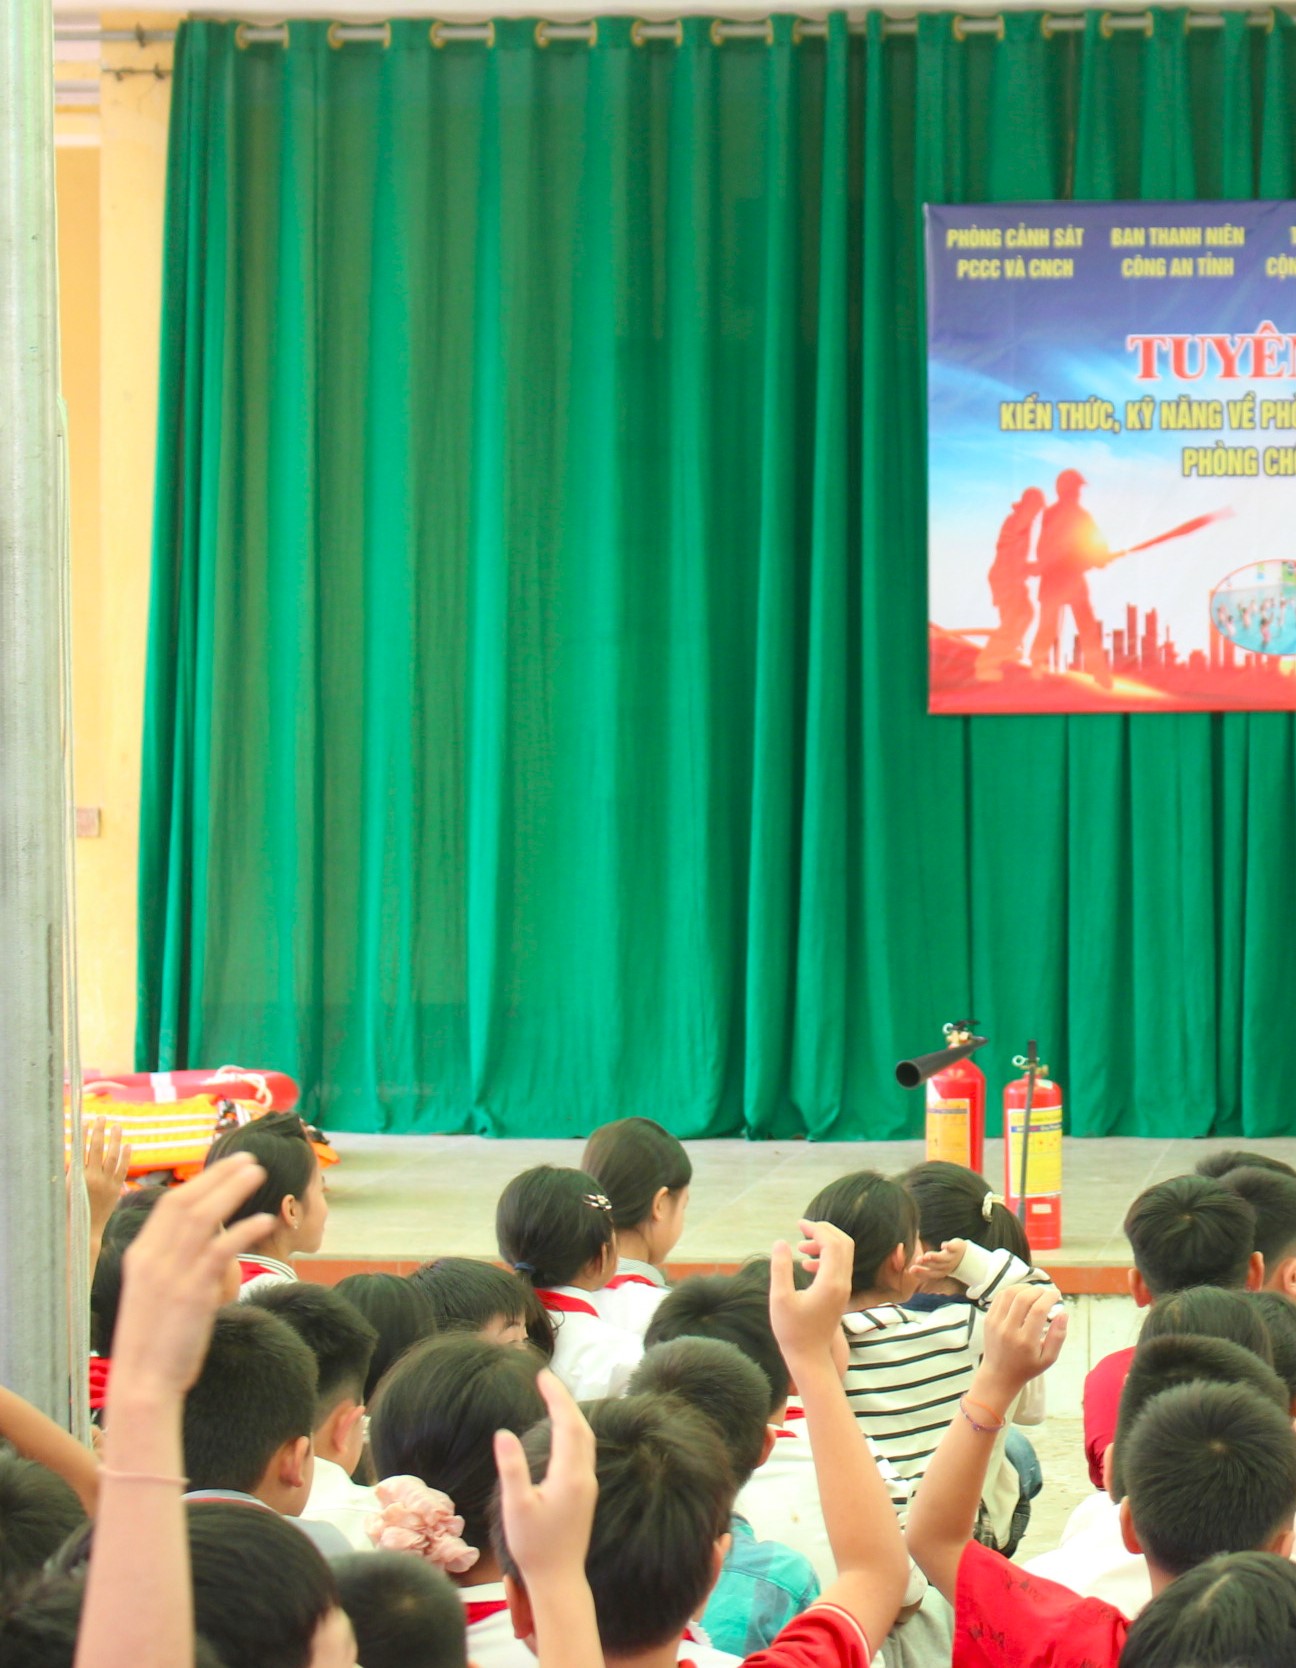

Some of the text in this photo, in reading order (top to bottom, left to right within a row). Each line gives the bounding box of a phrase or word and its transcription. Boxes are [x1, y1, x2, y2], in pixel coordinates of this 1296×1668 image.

[946, 222, 1085, 249] PHÒNG CẢNH SÁT
[1110, 223, 1246, 248] BAN THANH NIÊN
[957, 255, 1075, 278] PCCC VÀ CNCH
[1121, 251, 1235, 278] CÔNG AN TỈNH
[1000, 393, 1052, 432] KIẾN
[1057, 396, 1120, 434] THỨC,
[1125, 396, 1155, 430] KỸ
[1160, 396, 1223, 431] NĂNG
[1228, 392, 1256, 431] VỀ
[1181, 440, 1259, 478] PHÒNG
